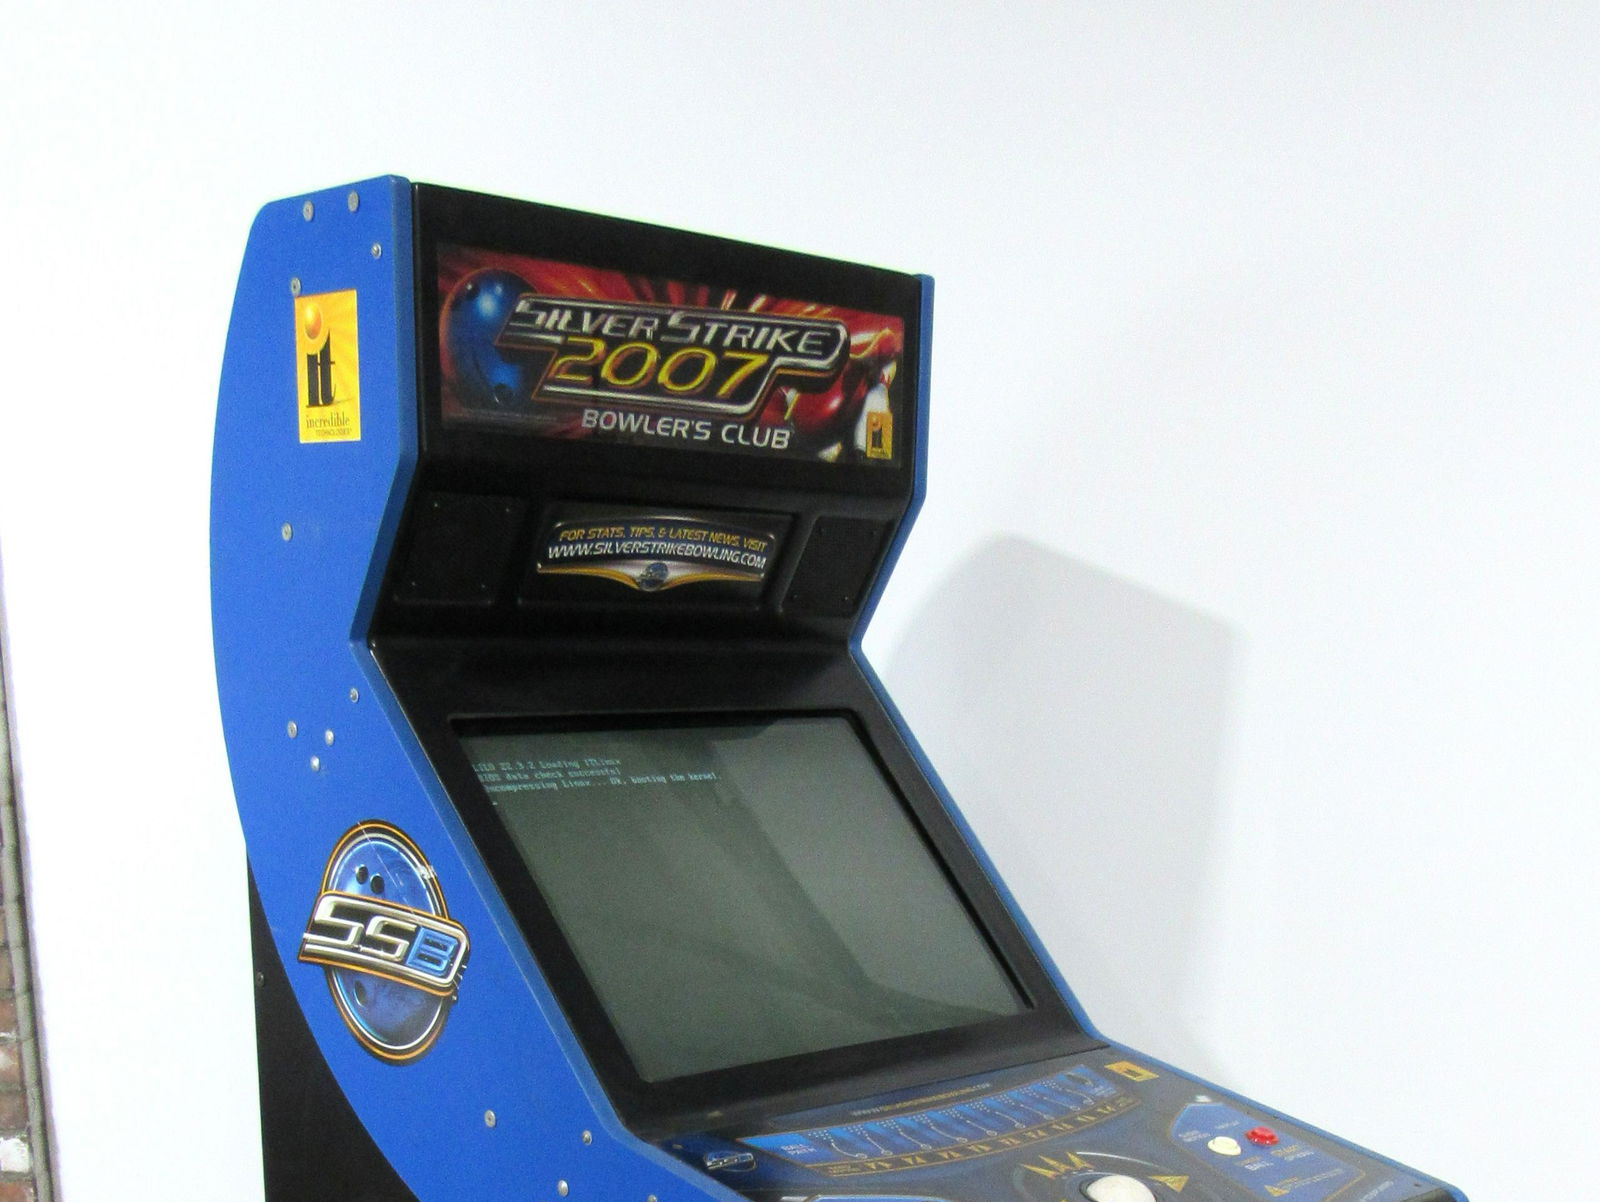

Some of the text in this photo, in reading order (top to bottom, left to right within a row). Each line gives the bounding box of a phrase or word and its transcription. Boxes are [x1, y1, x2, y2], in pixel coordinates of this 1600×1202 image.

[511, 299, 831, 355] SILVER STRIKE
[549, 336, 770, 398] 2007
[306, 411, 350, 429] incredible
[581, 408, 712, 441] BOWLER'S
[721, 423, 792, 450] CLUB
[548, 541, 767, 569] WWW.SILVERSTRIKEBOWLING.COM
[559, 529, 585, 541] FOR
[658, 527, 666, 538] &
[669, 529, 708, 541] LATEST
[743, 537, 768, 552] VISIT
[303, 896, 459, 976] SSB
